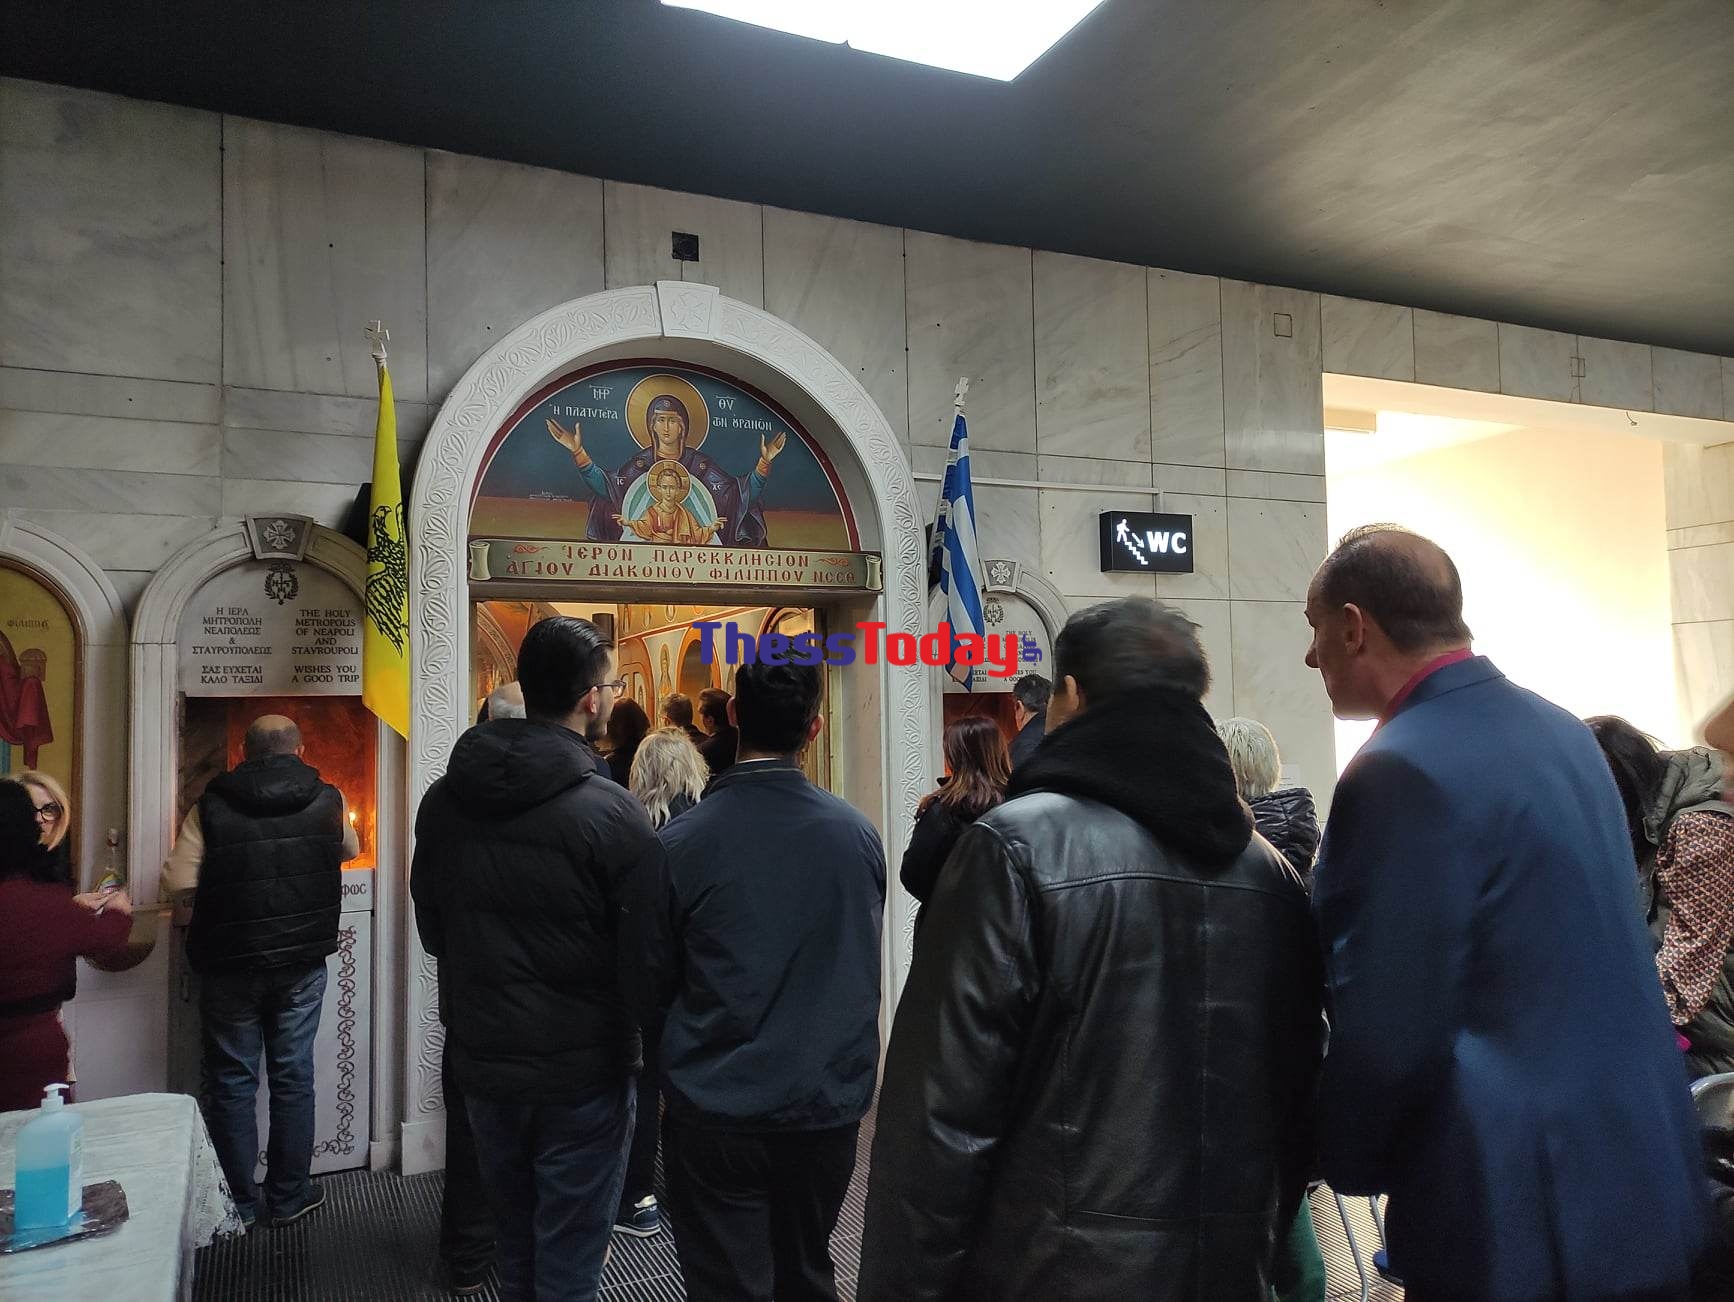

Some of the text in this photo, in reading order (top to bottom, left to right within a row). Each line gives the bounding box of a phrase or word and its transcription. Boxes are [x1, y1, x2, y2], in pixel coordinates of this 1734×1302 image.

[1146, 530, 1187, 554] WC
[216, 607, 249, 616] Η ΙΕΡΑ
[300, 609, 350, 618] THE HOLY
[203, 616, 262, 626] ΜΗΤΡΟΠΟΛΗ
[295, 619, 356, 627] METROPOLIS
[204, 626, 261, 635] ΝΕΑΠΟΛΕΩΣ
[296, 628, 354, 636] OF NEAPOLI
[229, 637, 236, 645] &
[315, 637, 337, 646] AND
[192, 646, 272, 655] ΣΤΑΥΡΟΥΠΟΛΕΩΣ
[202, 665, 262, 674] ΣΑΣ ΕΥΧΕΤΑΙ
[294, 665, 357, 674] WISHES YOU
[201, 675, 263, 684] ΚΑΛΟ ΤΑΞΙΔΙ
[291, 674, 360, 683] A GOOD TRIP
